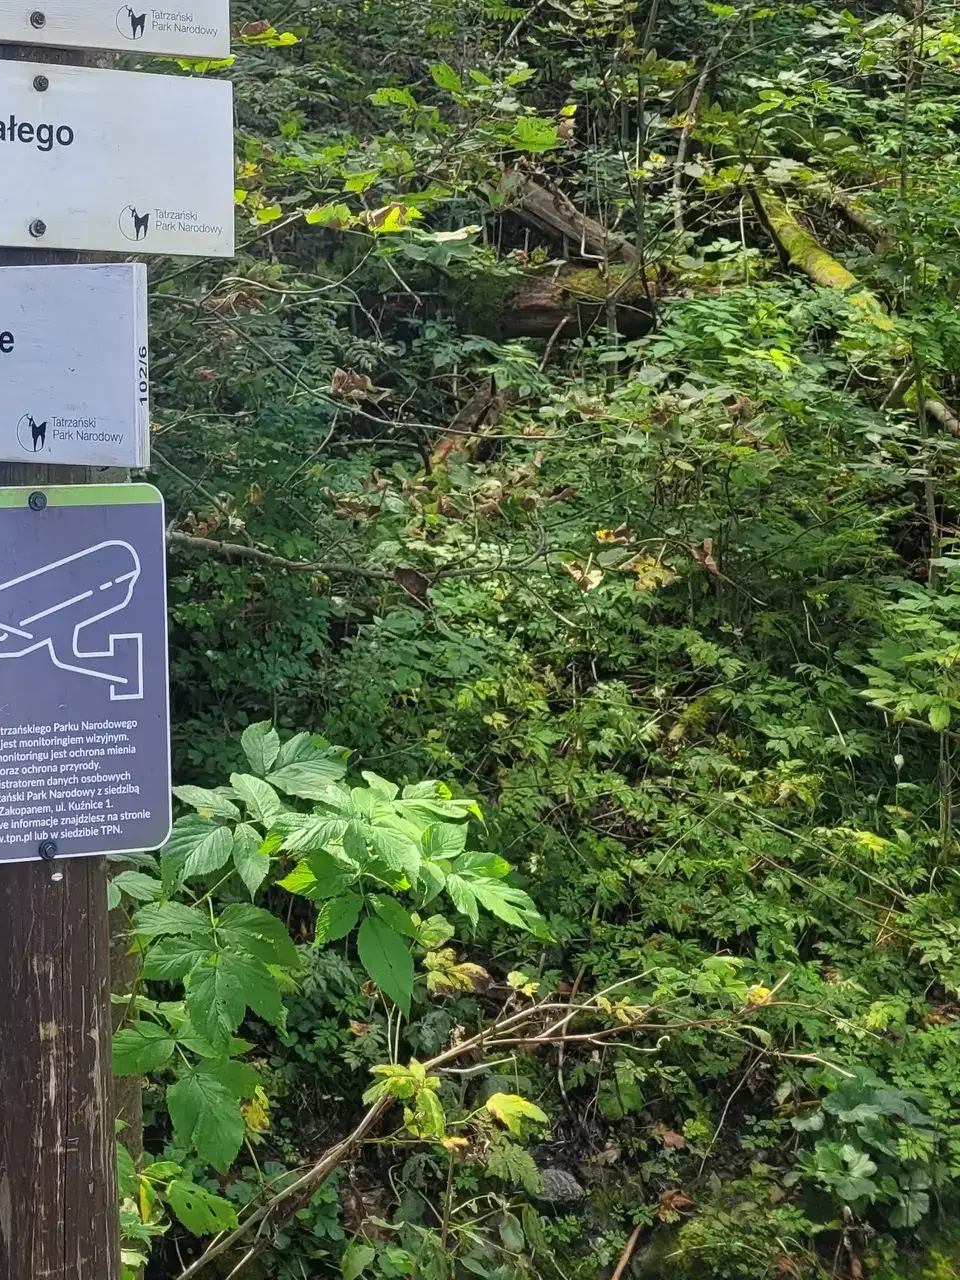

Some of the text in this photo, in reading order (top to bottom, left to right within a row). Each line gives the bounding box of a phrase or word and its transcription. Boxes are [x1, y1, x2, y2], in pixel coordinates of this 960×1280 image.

[150, 9, 193, 23] Tatrzański
[152, 21, 217, 37] Park Narodowy
[154, 208, 197, 221] Tatrzański
[155, 221, 222, 236] Park Narodowy
[138, 346, 148, 406] 102/6
[52, 417, 95, 428] Tatrzański
[53, 430, 123, 445] Park Narodowy
[54, 722, 79, 732] Parku
[81, 719, 138, 731] Narodowego
[0, 739, 17, 750] jest
[19, 735, 84, 749] monitoringiem
[86, 733, 129, 744] wizyjnym.
[50, 750, 67, 761] jest
[69, 747, 105, 757] ochrona
[107, 746, 136, 755] mienia
[0, 761, 101, 776] oraz ochrona przyrody.
[47, 775, 79, 787] danych
[81, 772, 131, 784] osobowych
[27, 791, 47, 801] Park
[50, 787, 95, 799] Narodowy
[104, 785, 140, 795] siedzibą
[56, 802, 66, 812] ul.
[68, 800, 103, 811] Kuźnice
[106, 799, 113, 808] 1.
[11, 818, 58, 830] informacje
[61, 814, 105, 825] znajdziesz
[107, 813, 118, 821] na
[120, 810, 151, 820] stronie
[35, 830, 48, 840] lub
[50, 831, 59, 839] w
[61, 827, 99, 838] siedzibie
[101, 825, 123, 835] TPN.
